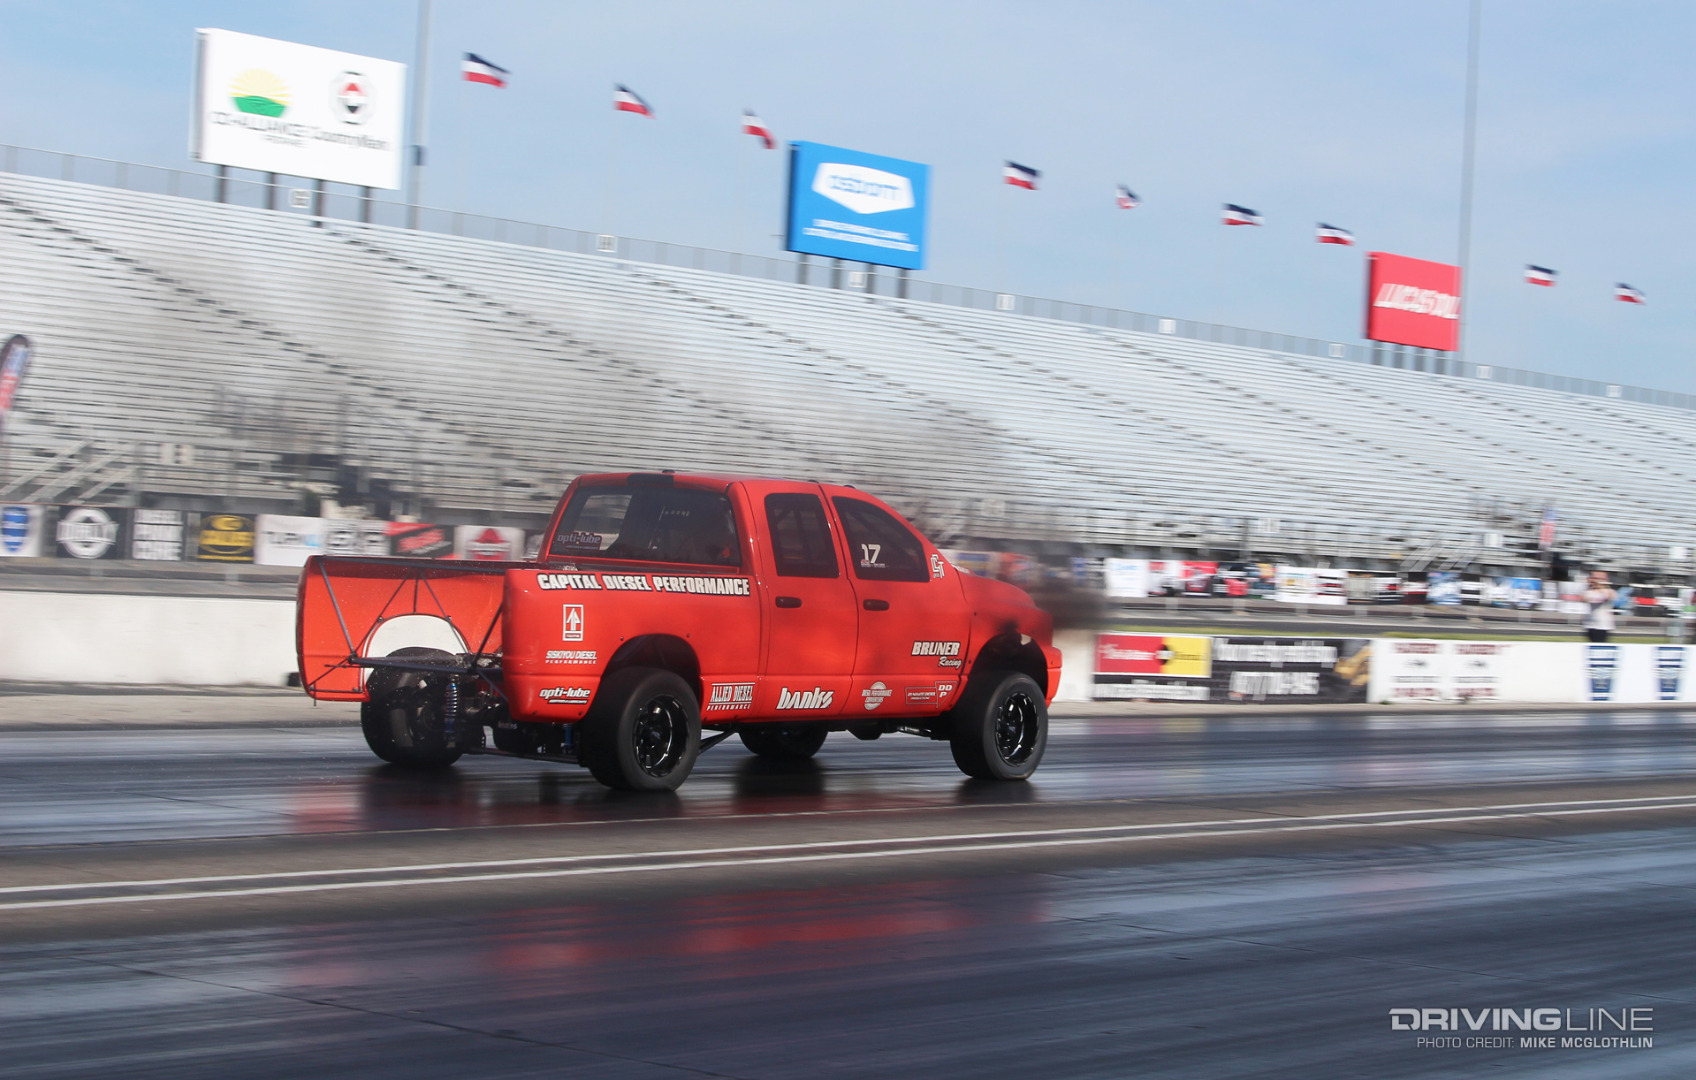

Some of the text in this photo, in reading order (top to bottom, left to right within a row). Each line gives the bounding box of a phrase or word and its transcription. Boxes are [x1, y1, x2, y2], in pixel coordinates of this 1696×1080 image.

[861, 543, 881, 564] 17
[536, 573, 750, 596] CAPITAL DIESEL PERFORMANCE
[575, 650, 598, 660] DIESEL
[911, 641, 961, 656] BRUNER
[938, 656, 962, 669] Racing
[539, 687, 592, 700] opti-lube
[710, 685, 754, 702] ALLIED DIESEL
[706, 703, 752, 711] PERFORMANCE
